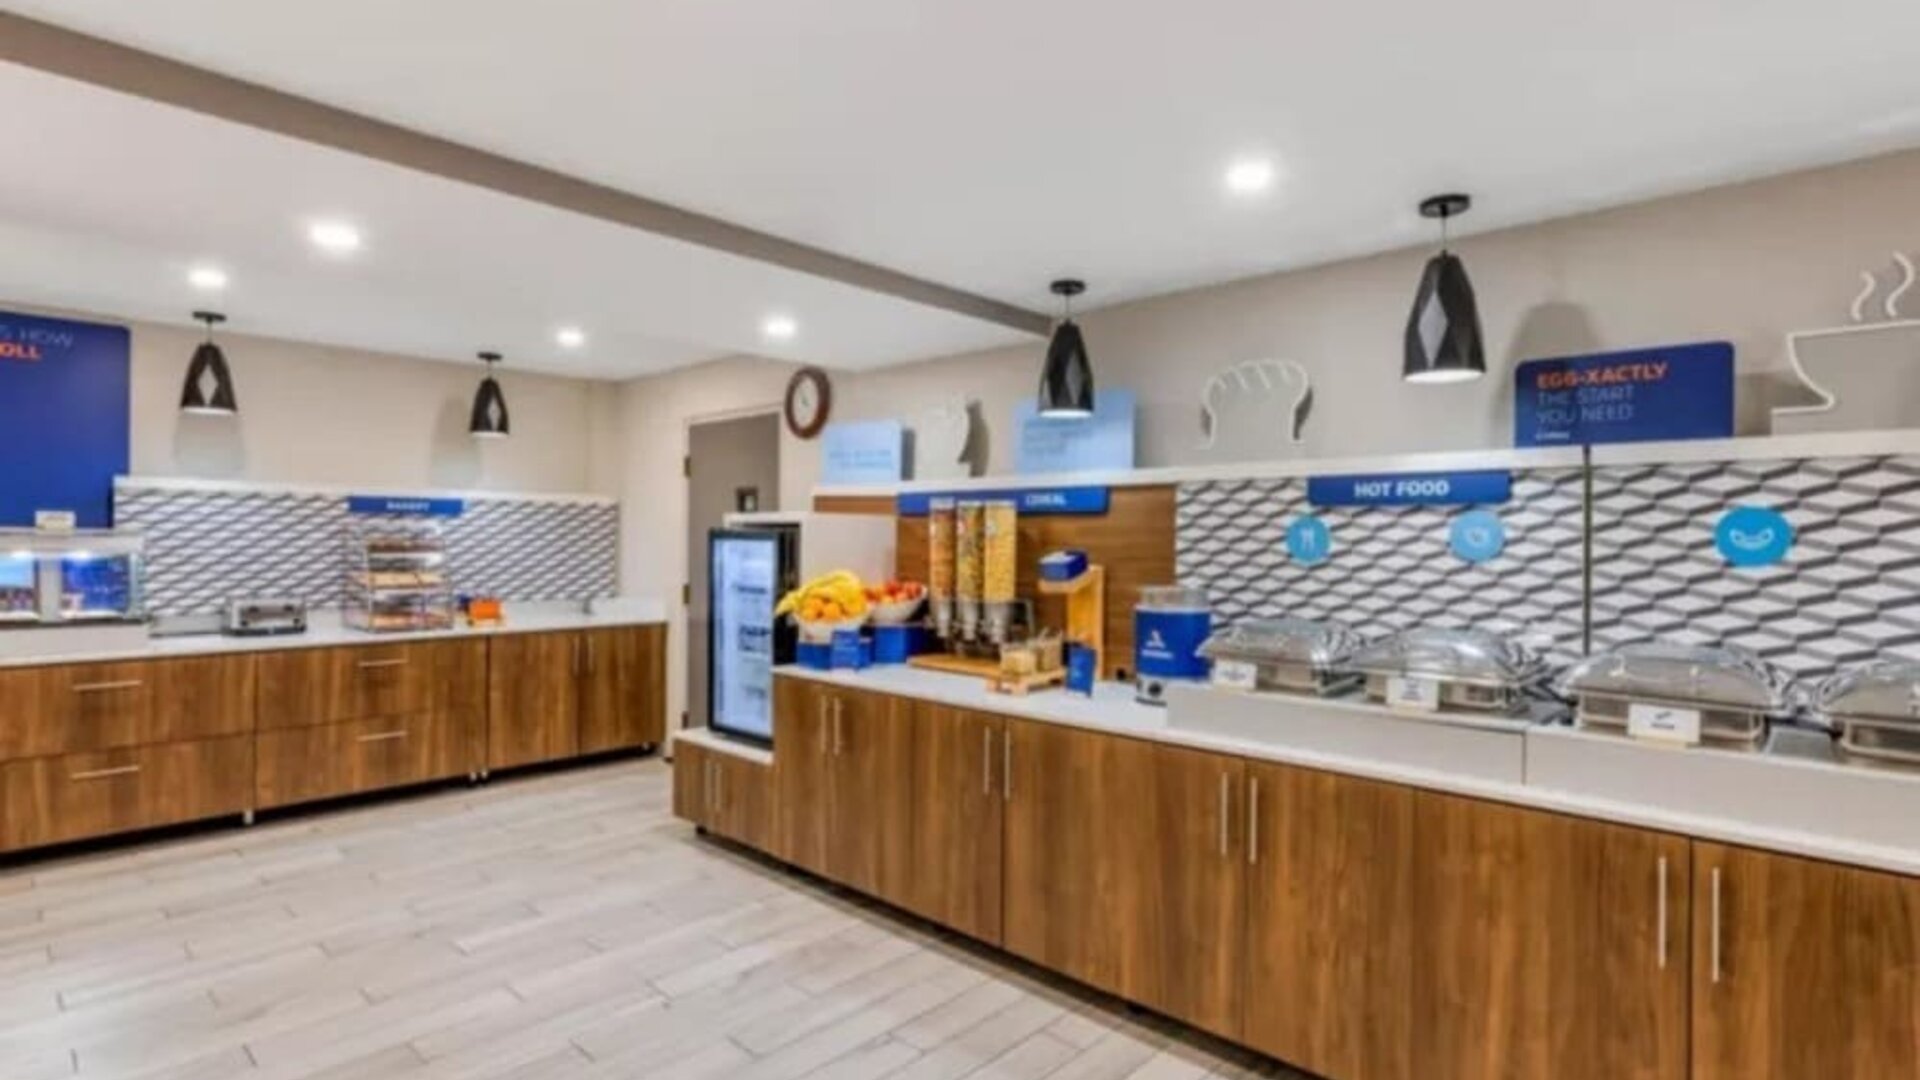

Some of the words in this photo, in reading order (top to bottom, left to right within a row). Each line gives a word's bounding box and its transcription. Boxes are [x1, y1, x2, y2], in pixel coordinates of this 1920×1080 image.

[19, 327, 74, 348] HOW
[1537, 362, 1667, 388] EGG-XACTLY
[1537, 391, 1569, 406] THE
[1578, 384, 1635, 405] START
[1536, 408, 1575, 424] YOU
[1581, 404, 1634, 422] NEED
[1353, 481, 1392, 498] HOT
[1395, 479, 1450, 497] FOOD
